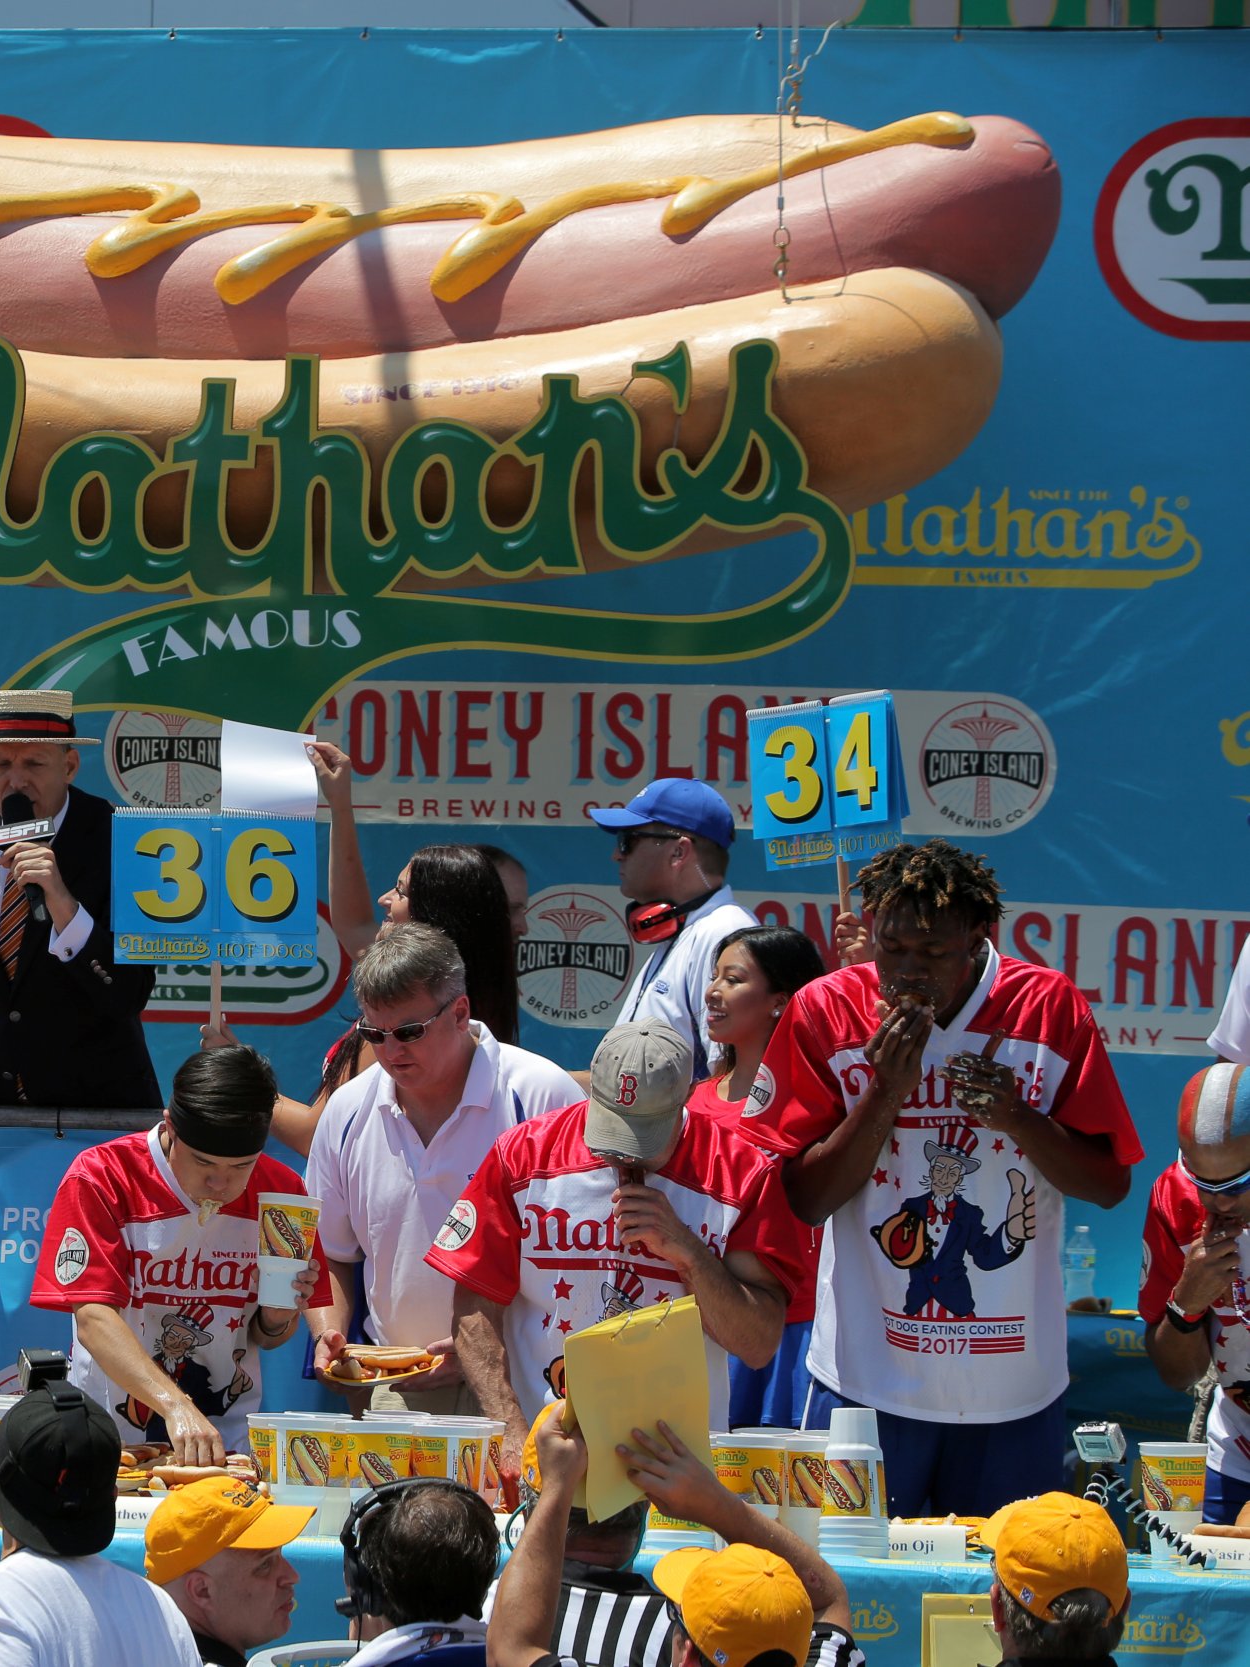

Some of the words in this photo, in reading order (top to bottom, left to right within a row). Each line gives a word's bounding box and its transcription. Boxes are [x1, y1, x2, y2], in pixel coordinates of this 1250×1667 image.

[953, 569, 1030, 584] FAMOUS
[121, 609, 362, 677] FAMOUS
[121, 738, 169, 768] CONEY
[763, 711, 878, 824] 34
[929, 752, 978, 781] CONEY
[983, 752, 1041, 785] ISLAND
[398, 799, 562, 819] BREWING
[940, 806, 1002, 830] BREWING
[839, 836, 864, 853] HOT
[869, 830, 901, 849] DOGS
[132, 828, 299, 924] 36
[217, 942, 257, 958] HOT
[262, 943, 315, 959] DOGS
[517, 942, 566, 973] CONEY
[571, 943, 625, 977] ISLAND
[993, 911, 1250, 1009] SLAN
[526, 995, 588, 1021] BREWING
[615, 1073, 638, 1107] B
[212, 1250, 237, 1259] SINCE
[896, 1322, 918, 1333] DOG
[922, 1324, 965, 1335] EATING
[969, 1323, 1024, 1335] CONTEST
[921, 1337, 968, 1355] 2017
[912, 1540, 934, 1555] Oji
